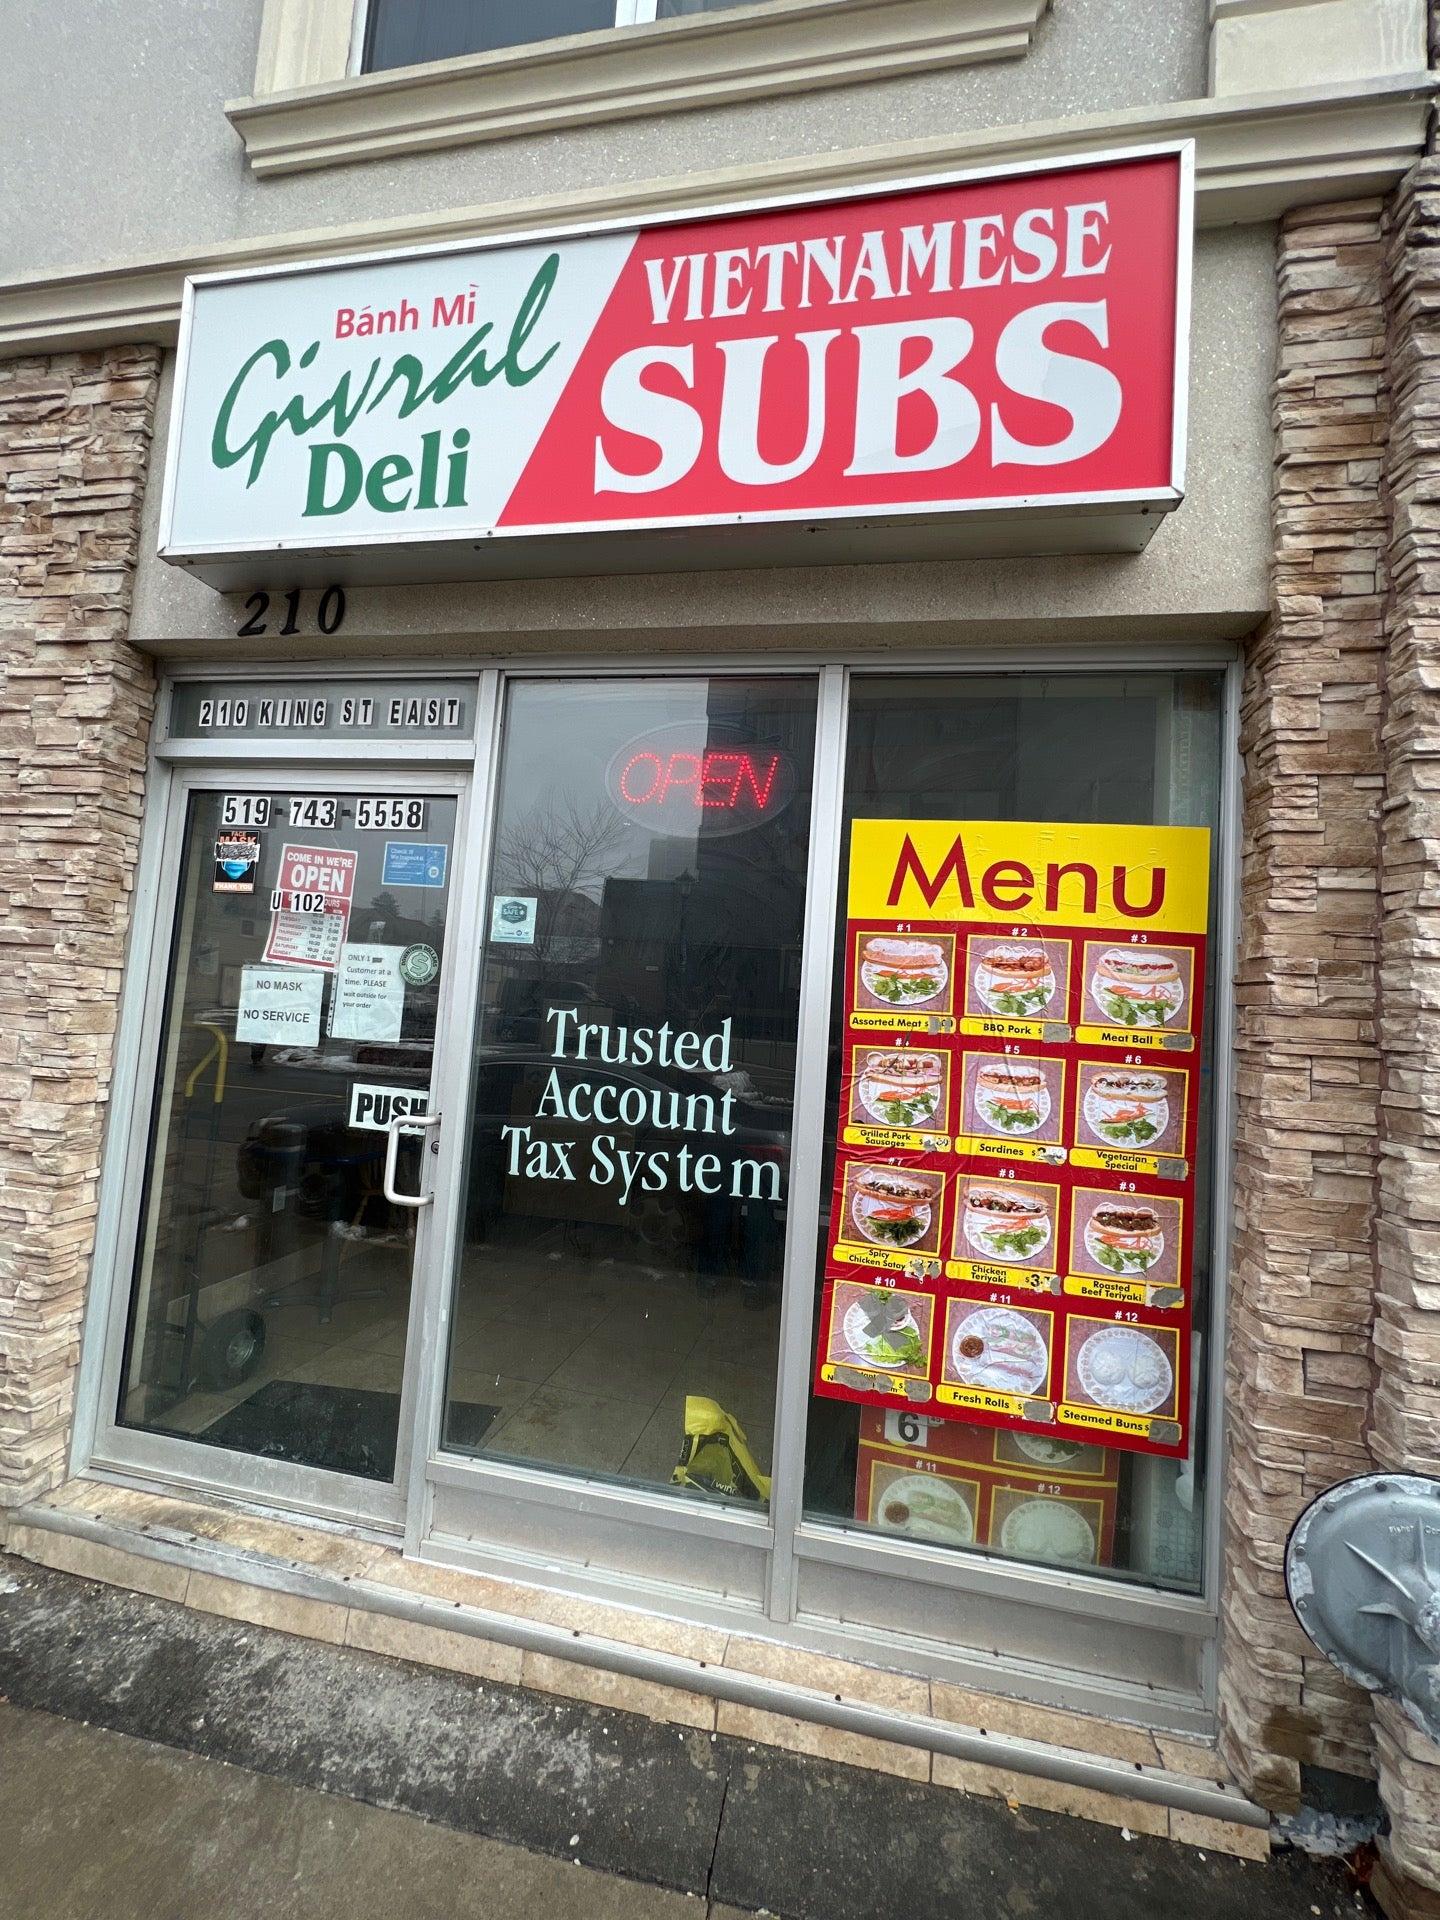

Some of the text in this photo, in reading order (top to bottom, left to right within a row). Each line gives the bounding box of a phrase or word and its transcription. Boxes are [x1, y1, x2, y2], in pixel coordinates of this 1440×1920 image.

[643, 201, 1113, 325] VIETNAMESE
[335, 299, 419, 339] Bánh
[211, 252, 560, 489] Givral
[594, 298, 1122, 495] SUBS
[301, 428, 471, 518] Deli
[237, 585, 345, 636] 210
[201, 699, 458, 725] 210 KING ST EAST
[620, 752, 779, 808] OPEN
[287, 852, 353, 868] COME IN WE'RE
[291, 864, 346, 893] OPEN
[886, 832, 1166, 918] Menu
[272, 892, 282, 910] U
[294, 894, 324, 912] 102
[346, 966, 377, 975] Customer
[256, 980, 303, 992] NO MASK
[344, 978, 387, 988] time. PLEASE
[342, 1001, 355, 1009] your
[243, 1009, 311, 1023] NO SERVICE
[852, 1017, 894, 1028] Assorted
[897, 1018, 922, 1029] Meat
[983, 1023, 1005, 1034] BBQ
[1008, 1024, 1032, 1035] Pork
[546, 1006, 734, 1074] Trusted
[1101, 1032, 1129, 1043] Meat
[1132, 1034, 1153, 1045] Ball
[535, 1066, 737, 1136] Account
[356, 1092, 428, 1129] PUSH
[860, 1129, 911, 1142] Grilled Pork
[865, 1137, 906, 1148] Sausages
[979, 1143, 1024, 1156] Sardines
[1097, 1150, 1148, 1164] Vegetarian
[500, 1125, 783, 1206] Tax System
[1105, 1161, 1138, 1171] Special
[848, 1254, 881, 1267] Chicken
[882, 1259, 907, 1272] Satay
[868, 1249, 890, 1260] Spicy
[970, 1271, 1007, 1285] Teriyaki
[971, 1264, 1007, 1276] Chicken
[1081, 1286, 1142, 1303] Beef Teriyaki
[1093, 1280, 1131, 1293] Roasted
[952, 1391, 982, 1405] Fresh
[984, 1396, 1010, 1410] Rolls
[1063, 1409, 1112, 1426] Steamed
[1116, 1419, 1143, 1431] Buns
